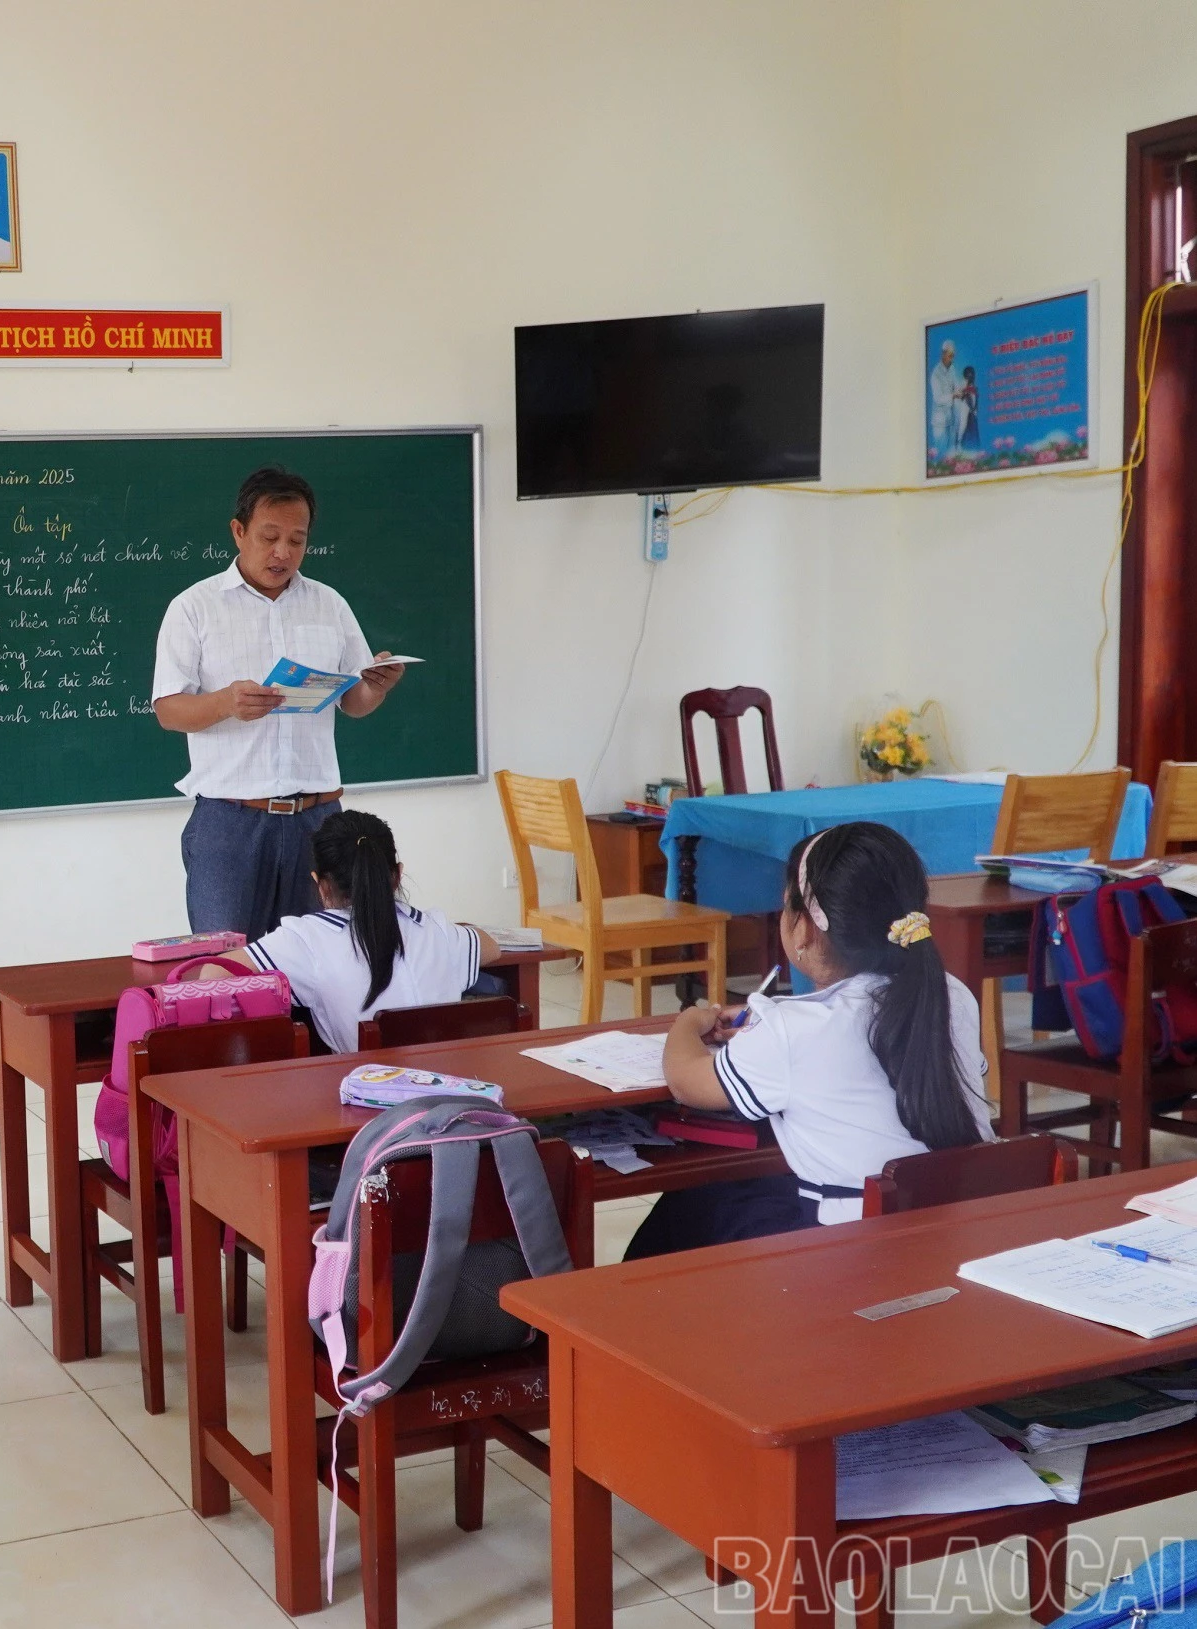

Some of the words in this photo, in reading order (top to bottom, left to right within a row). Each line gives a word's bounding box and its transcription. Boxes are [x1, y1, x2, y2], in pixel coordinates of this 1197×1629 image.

[63, 315, 95, 349] HỒ
[104, 320, 144, 349] CHÍ
[152, 327, 213, 349] MINH
[38, 468, 75, 485] 2025
[13, 505, 34, 534] Ôn
[44, 514, 72, 541] tập
[20, 546, 46, 571] một
[55, 544, 78, 564] số
[81, 538, 106, 563] nét
[114, 537, 163, 561] chính
[171, 541, 192, 560] về
[202, 543, 230, 565] địa
[2, 575, 53, 596] thành
[8, 611, 49, 629] nhiên
[58, 605, 80, 625] nổi
[34, 640, 63, 658] sản
[18, 670, 47, 689] hoá
[58, 672, 82, 694] đặc
[40, 701, 80, 720] nhân
[86, 700, 119, 718] tiêu
